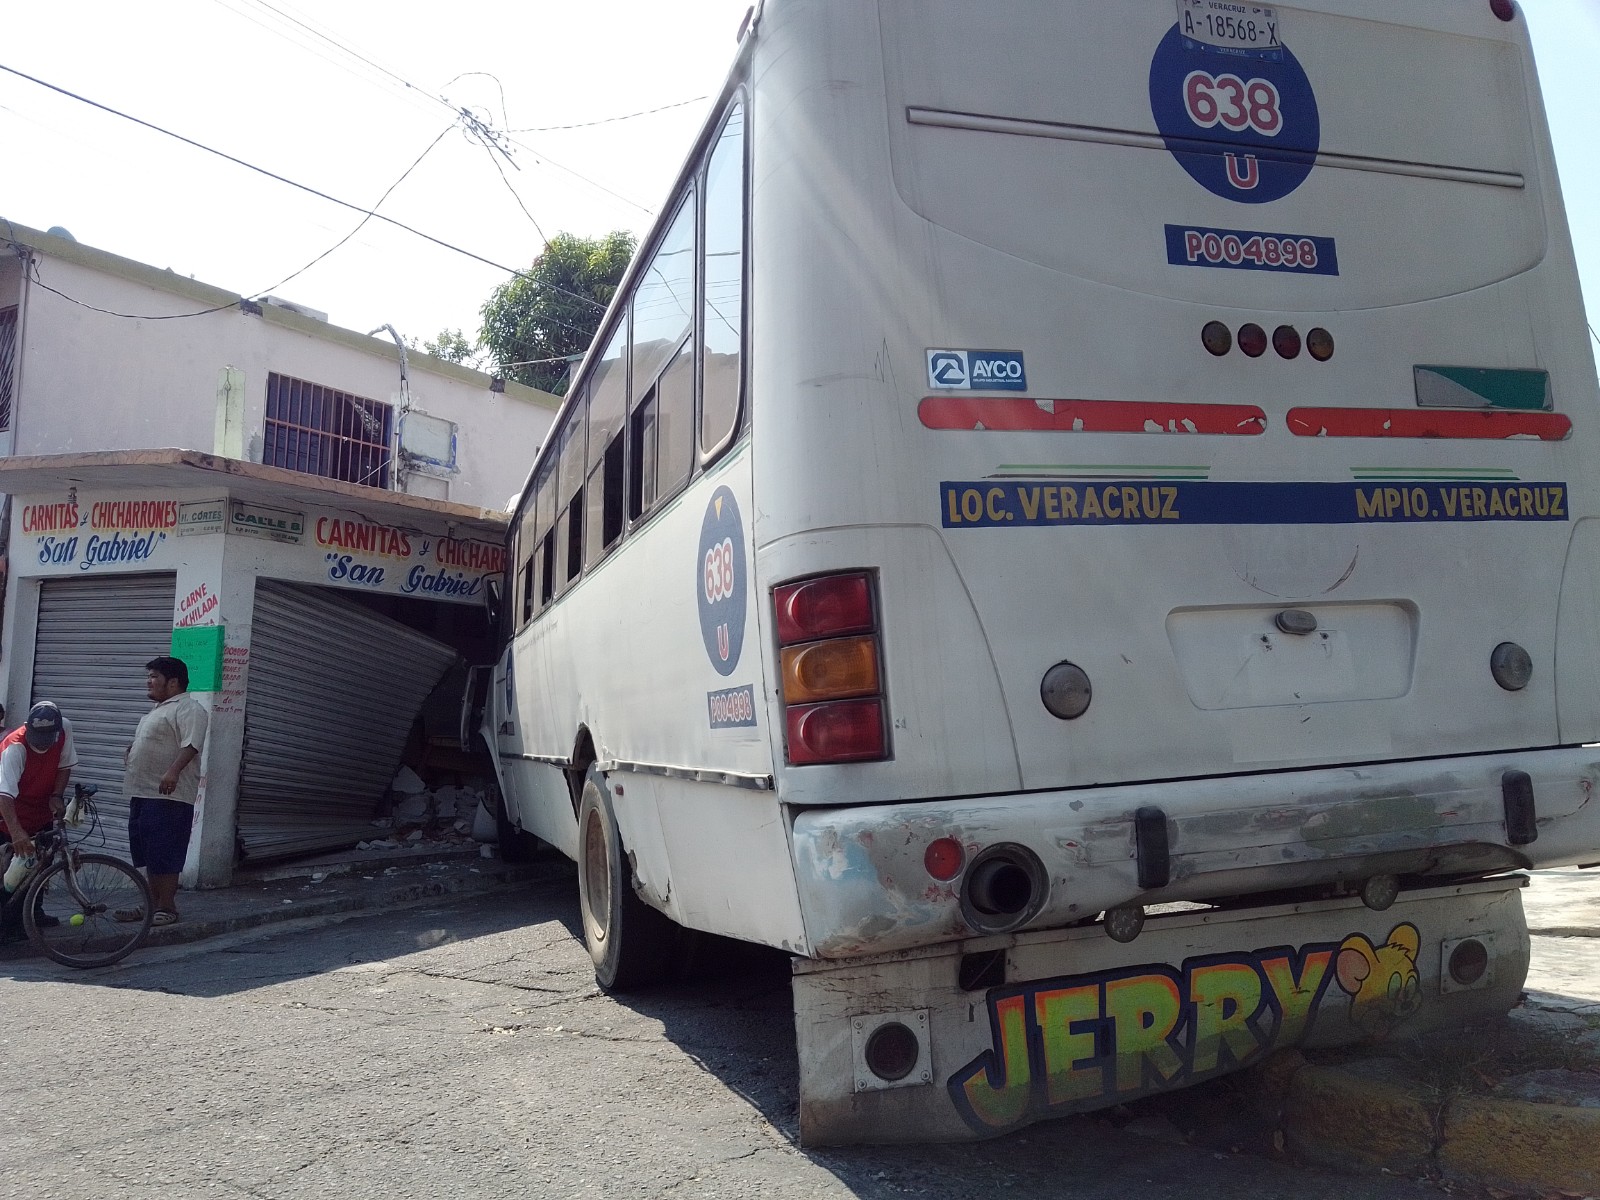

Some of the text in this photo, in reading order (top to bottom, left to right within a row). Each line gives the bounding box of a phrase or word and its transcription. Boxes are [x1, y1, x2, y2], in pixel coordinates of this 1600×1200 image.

[1209, 2, 1246, 13] VERACRUZ
[1185, 10, 1278, 45] A-18568-X
[1183, 70, 1283, 137] 638
[1224, 152, 1259, 190] U
[1184, 231, 1318, 268] P004898
[973, 360, 1021, 377] AYCO
[22, 502, 79, 532] CARNITAS
[91, 500, 177, 528] CHICHARRONES
[234, 512, 286, 528] CALLE
[948, 486, 1180, 523] LOC. VERACRUZ
[1355, 487, 1564, 518] MPIO. VERACRUZ
[316, 517, 411, 556] CARNITAS
[419, 540, 430, 555] y
[401, 565, 481, 596] Gabriel
[704, 537, 733, 604] 638
[181, 583, 207, 612] CARNE
[716, 623, 729, 661] U
[710, 690, 752, 723] P004898
[950, 943, 1340, 1134] JERRY
